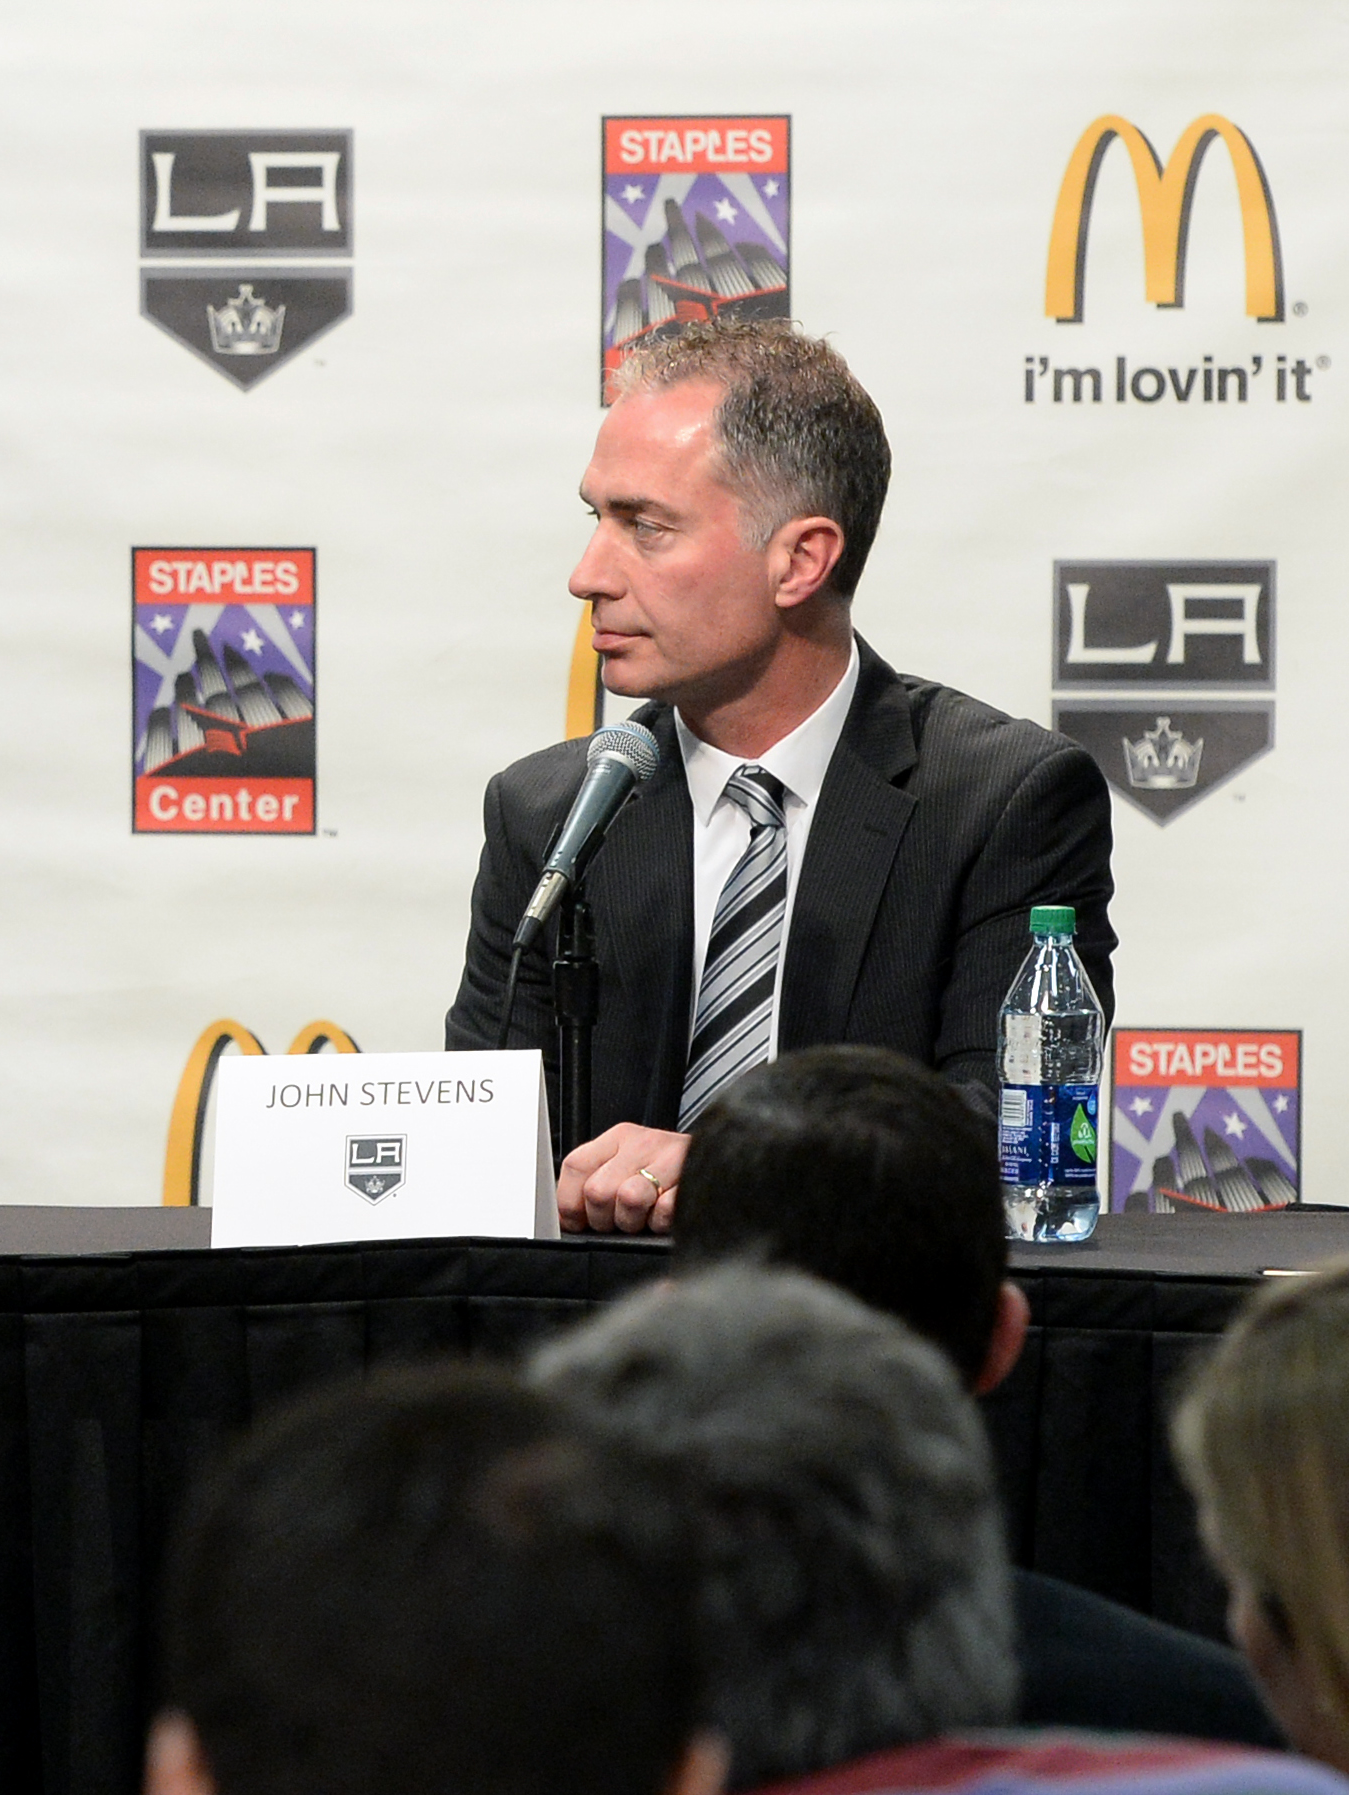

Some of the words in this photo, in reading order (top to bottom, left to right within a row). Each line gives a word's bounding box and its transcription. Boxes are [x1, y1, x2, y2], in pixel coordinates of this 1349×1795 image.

[618, 127, 775, 165] STAPLES
[152, 151, 342, 232] LA
[1025, 356, 1102, 403] i'm
[148, 559, 301, 596] STAPLES
[1065, 583, 1263, 664] LA
[149, 785, 301, 823] Center
[1128, 1041, 1285, 1079] STAPLES
[266, 1083, 349, 1109] JOHN
[360, 1078, 494, 1106] STEVENS
[350, 1142, 401, 1165] LA
